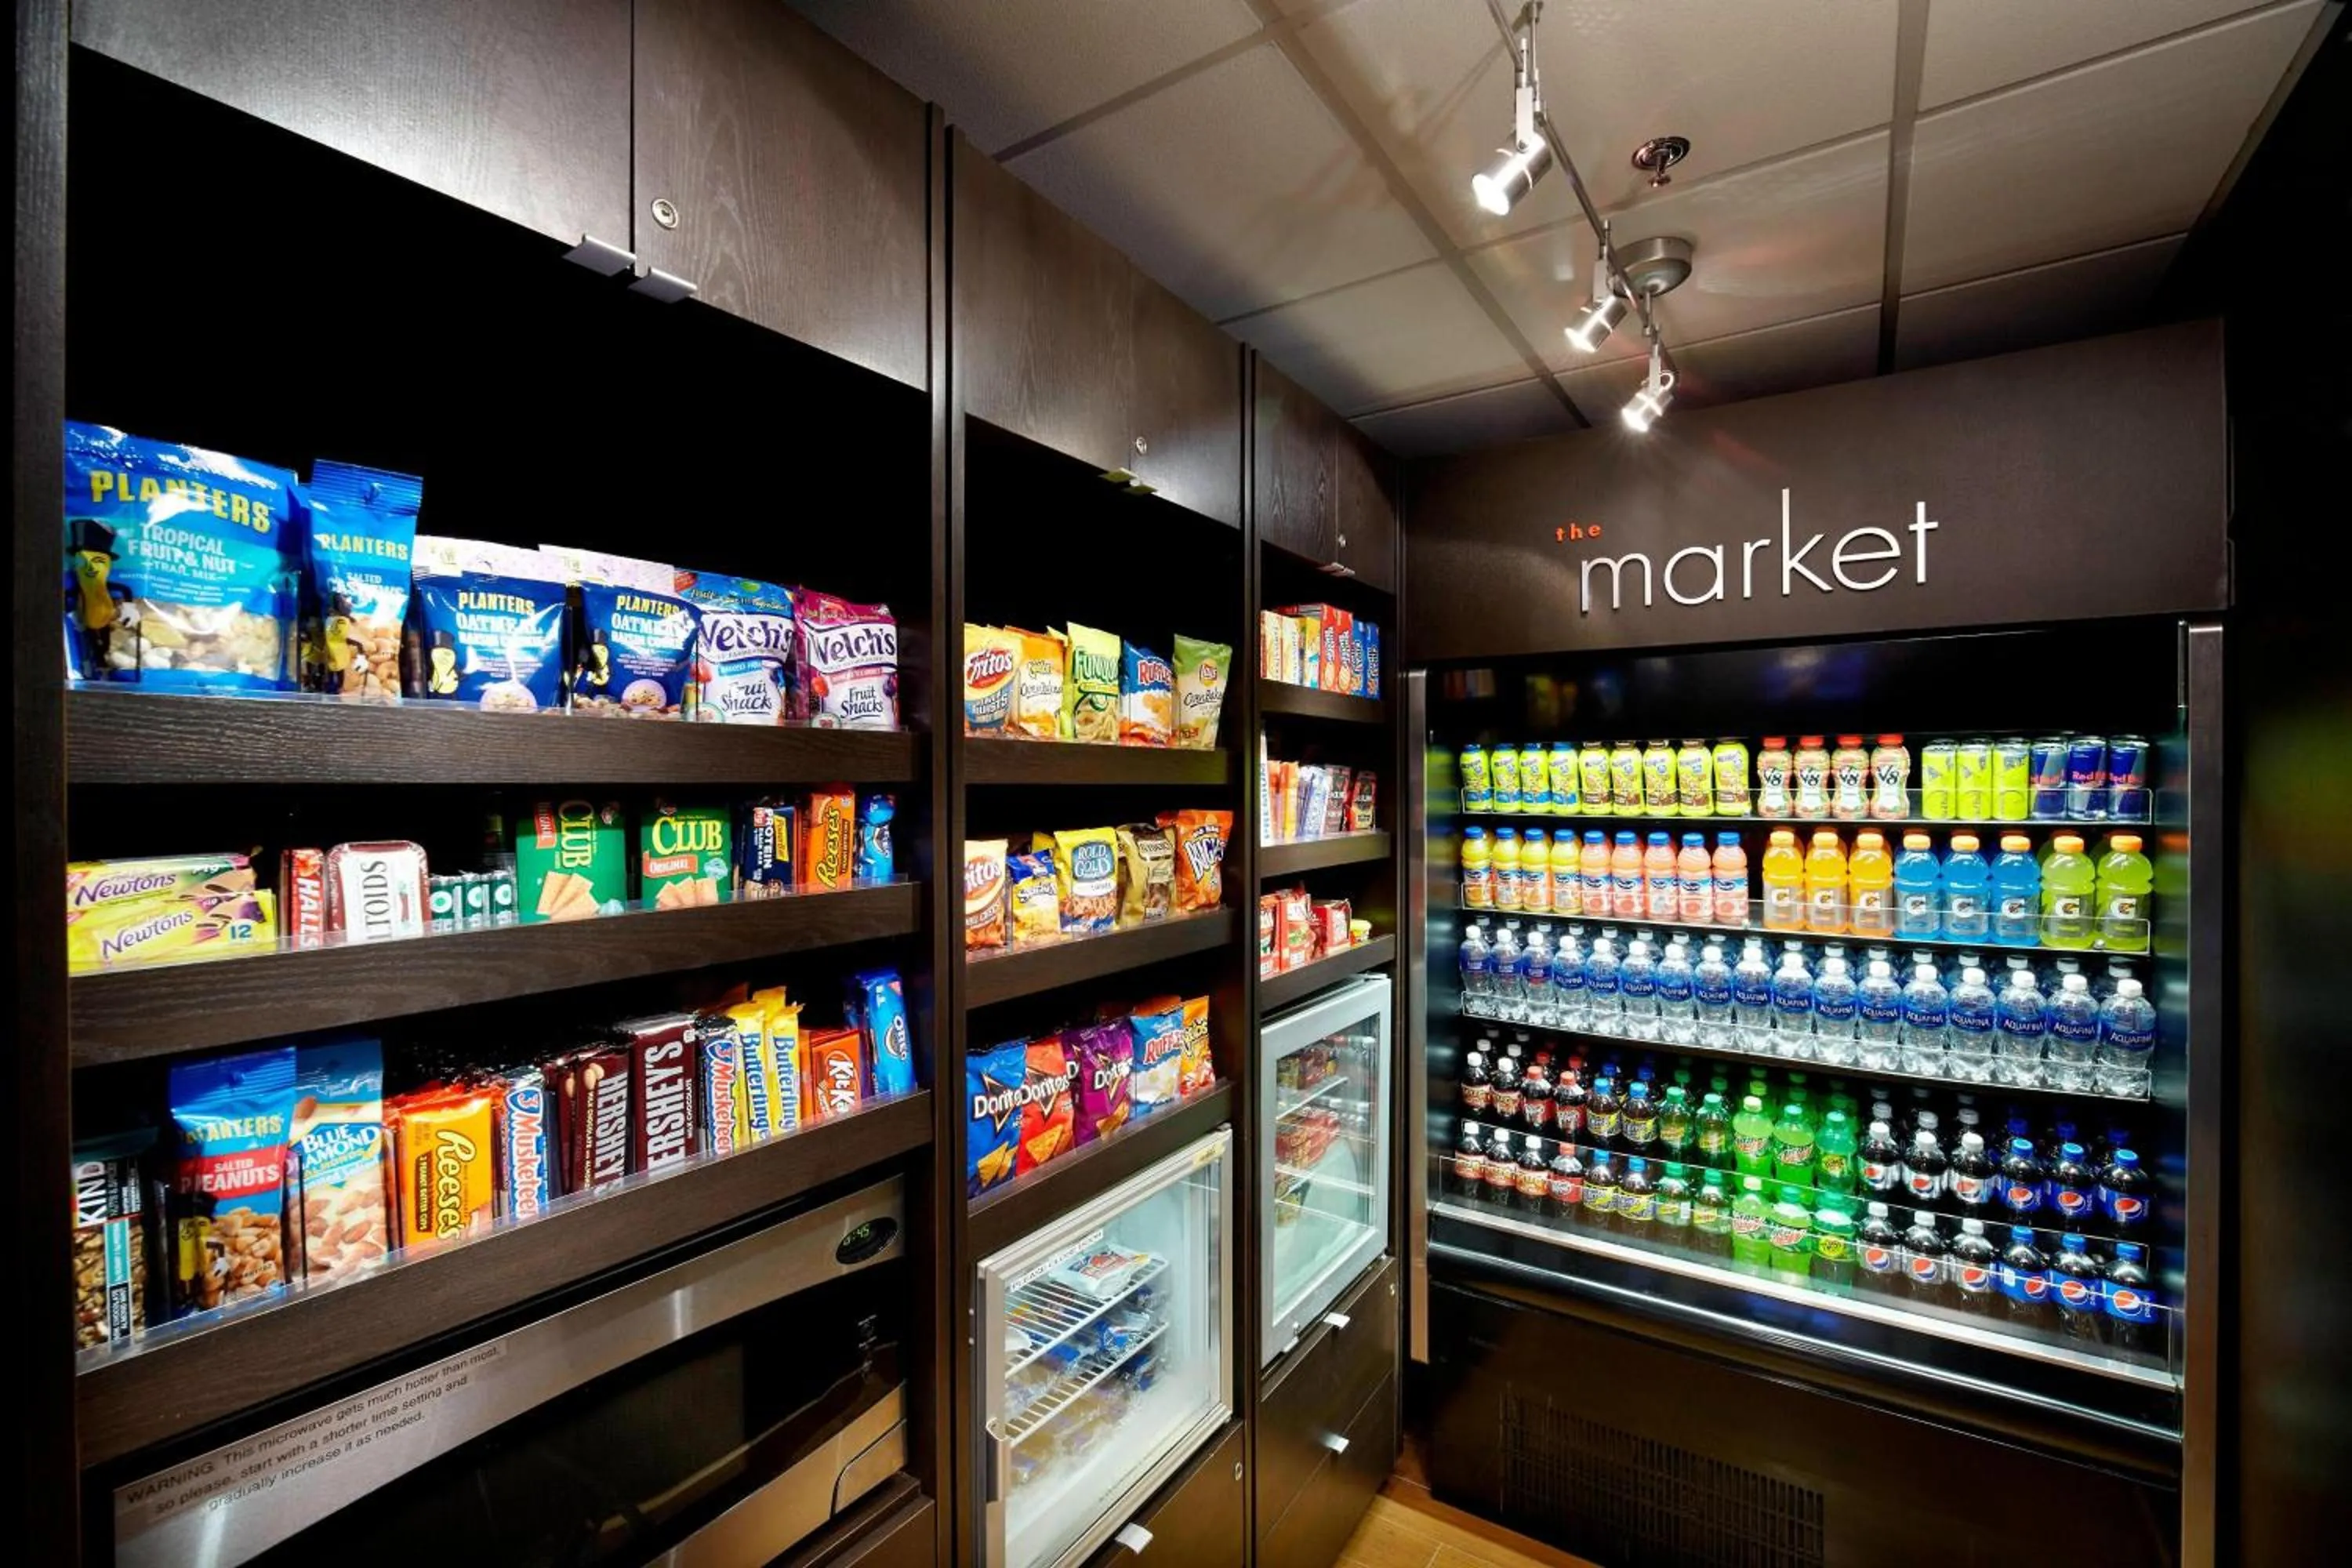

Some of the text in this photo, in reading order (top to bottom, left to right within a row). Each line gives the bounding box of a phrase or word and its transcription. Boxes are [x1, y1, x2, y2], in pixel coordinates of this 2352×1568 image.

[90, 471, 270, 533] PLANTERS
[140, 523, 226, 556] TROPICAL
[1555, 522, 1601, 542] the
[321, 533, 408, 561] PLANTERS
[1581, 488, 1938, 612] market
[201, 554, 236, 574] NUT
[459, 592, 535, 615] PLANTERS
[808, 628, 896, 665] Welch's
[966, 649, 1013, 685] Fritos
[849, 686, 877, 700] Fruit
[840, 699, 884, 718] Snacks
[1839, 765, 1859, 786] V8
[1878, 765, 1899, 786] V8
[558, 800, 594, 868] CLUB
[652, 816, 722, 855] CLUB
[763, 808, 775, 869] PROTEIN
[816, 808, 840, 889] Reese's
[1078, 844, 1108, 860] ROLD
[965, 859, 1001, 894] ritos
[1075, 858, 1111, 877] GOLD
[74, 873, 176, 907] Newtons
[297, 877, 321, 948] HALLS
[103, 910, 194, 960] Newtons
[230, 924, 252, 939] 12
[1776, 995, 1809, 1007] AQUAFINA
[1820, 1004, 1854, 1016] AQUAFINA
[1862, 1006, 1898, 1018] AQUAFINA
[1906, 1010, 1944, 1024] AQUAFINA
[1950, 1011, 1991, 1027] AQUAFINA
[2003, 1019, 2044, 1033] AQUAFINA
[2053, 1021, 2096, 1036] AQUAFINA
[517, 1093, 539, 1109] 3
[302, 1123, 350, 1153] BLUE
[214, 1157, 255, 1173] SALTED
[78, 1160, 107, 1225] KIND
[436, 1130, 476, 1241] Reese's
[224, 1447, 255, 1465] This
[259, 1414, 332, 1452] microwave
[336, 1402, 365, 1420] gets
[368, 1387, 402, 1407] much
[405, 1372, 440, 1392] hotter
[442, 1360, 468, 1377] than
[157, 1500, 175, 1513] so
[240, 1458, 273, 1479] start
[276, 1443, 306, 1463] with
[309, 1439, 318, 1450] a
[322, 1418, 367, 1444] shorter
[371, 1406, 398, 1424] time
[402, 1386, 442, 1410] setting
[445, 1375, 468, 1392] and
[208, 1474, 276, 1512] gradually
[281, 1447, 341, 1480] increase
[355, 1435, 372, 1448] as
[376, 1411, 425, 1439] needed.
